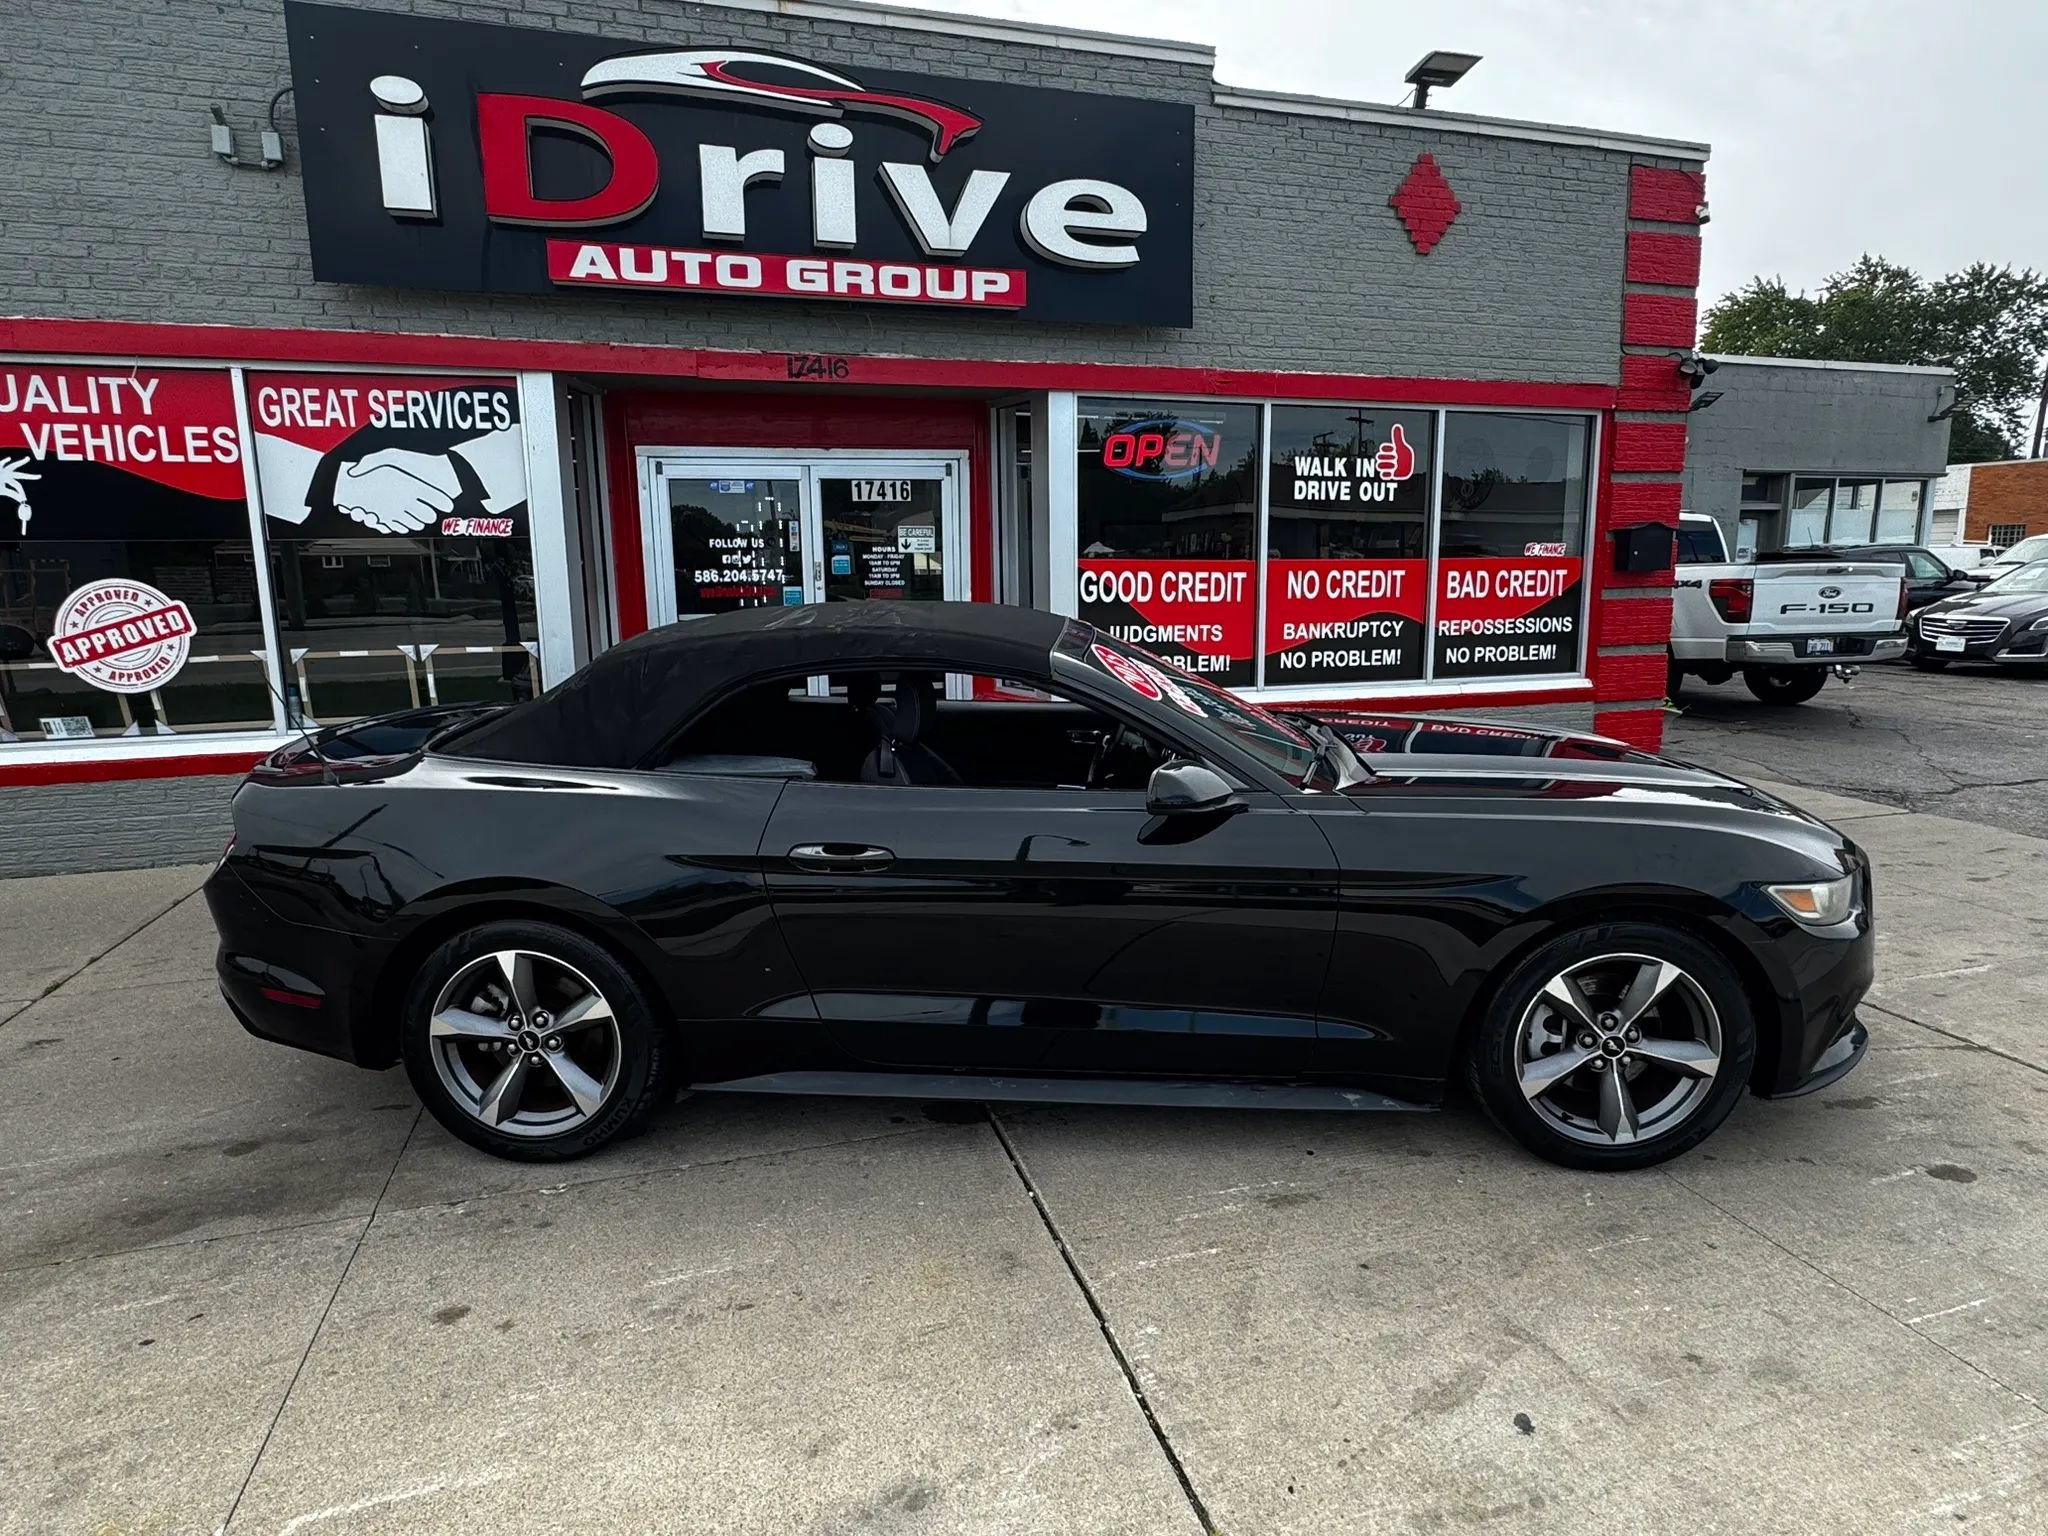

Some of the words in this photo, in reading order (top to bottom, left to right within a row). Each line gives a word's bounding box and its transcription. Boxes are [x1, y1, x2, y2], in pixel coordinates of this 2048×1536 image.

[369, 75, 1149, 269] iDrive
[568, 244, 762, 289] AUTO
[786, 258, 1011, 303] GROUP
[0, 374, 159, 416] UALITY
[258, 387, 358, 428] GREAT
[369, 390, 511, 431] SERVICES
[20, 423, 239, 463] VEHICLES
[1104, 434, 1221, 467] OPEN
[1294, 456, 1346, 478] WALK
[1355, 456, 1375, 478] IN
[855, 481, 909, 500] 17416
[1294, 480, 1351, 502] DRIVE
[1359, 481, 1398, 502] OUT
[443, 519, 460, 533] WE
[465, 519, 513, 534] FINANCE
[709, 538, 748, 548] FOLLOW
[751, 538, 765, 548] US
[1525, 543, 1536, 554] WE
[1538, 543, 1565, 555] FINANCE
[1080, 570, 1153, 603] GOOD
[1160, 570, 1247, 603] CREDIT
[1287, 570, 1320, 598] NO
[1326, 569, 1406, 598] CREDIT
[1446, 570, 1486, 599] BAD
[1491, 569, 1568, 598] CREDIT
[75, 589, 140, 617] APPROVED
[1780, 603, 1874, 614] F-150
[60, 610, 186, 663] APPROVED
[1283, 621, 1404, 640] BANKRUPTCY
[1438, 616, 1572, 636] REPOSSESSIONS
[1160, 654, 1231, 672] BLEM!
[1280, 651, 1306, 670] NO
[1311, 649, 1402, 669] PROBLEM!
[1445, 646, 1469, 664] NO
[1472, 644, 1557, 663] PROBLEM!
[109, 656, 171, 683] APPROVED
